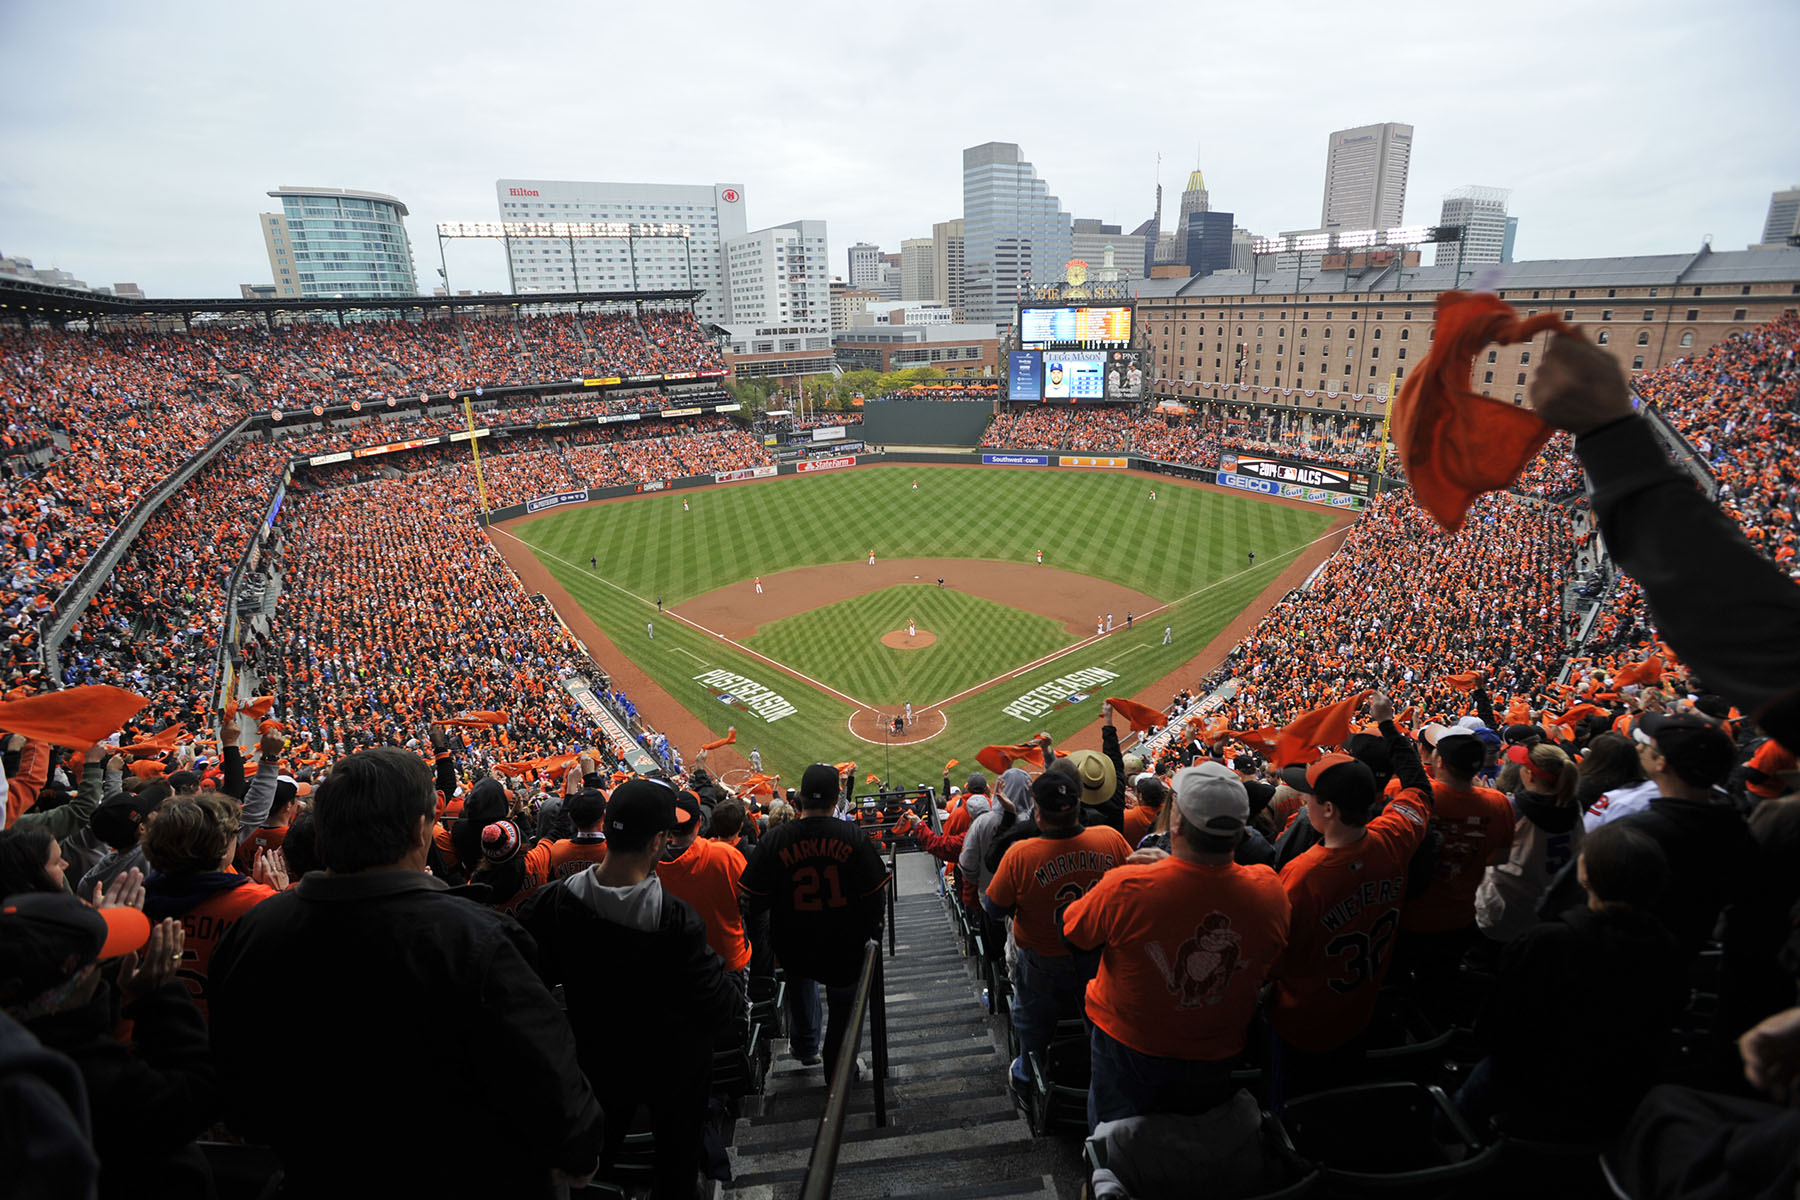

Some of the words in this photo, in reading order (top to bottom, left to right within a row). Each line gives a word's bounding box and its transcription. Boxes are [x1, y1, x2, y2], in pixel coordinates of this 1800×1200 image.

[509, 188, 540, 197] Hilton
[1036, 288, 1059, 299] THE
[1094, 288, 1118, 298] SUN
[1048, 353, 1071, 361] LEGG
[1072, 353, 1101, 361] MASON
[1122, 352, 1140, 360] PNC
[1259, 462, 1278, 478] 2014
[1297, 468, 1322, 485] ALCS
[1225, 474, 1271, 493] GEICO
[1285, 488, 1302, 496] Gulf
[1308, 492, 1326, 500] Gulf
[1332, 497, 1351, 506] Gulf
[692, 669, 798, 723] POSTSEASON
[1002, 666, 1120, 722] POSTSEASON
[778, 838, 854, 868] MARKAKIS
[1034, 850, 1114, 888] MARKAKIS
[792, 864, 848, 910] 21
[1326, 907, 1400, 994] 32
